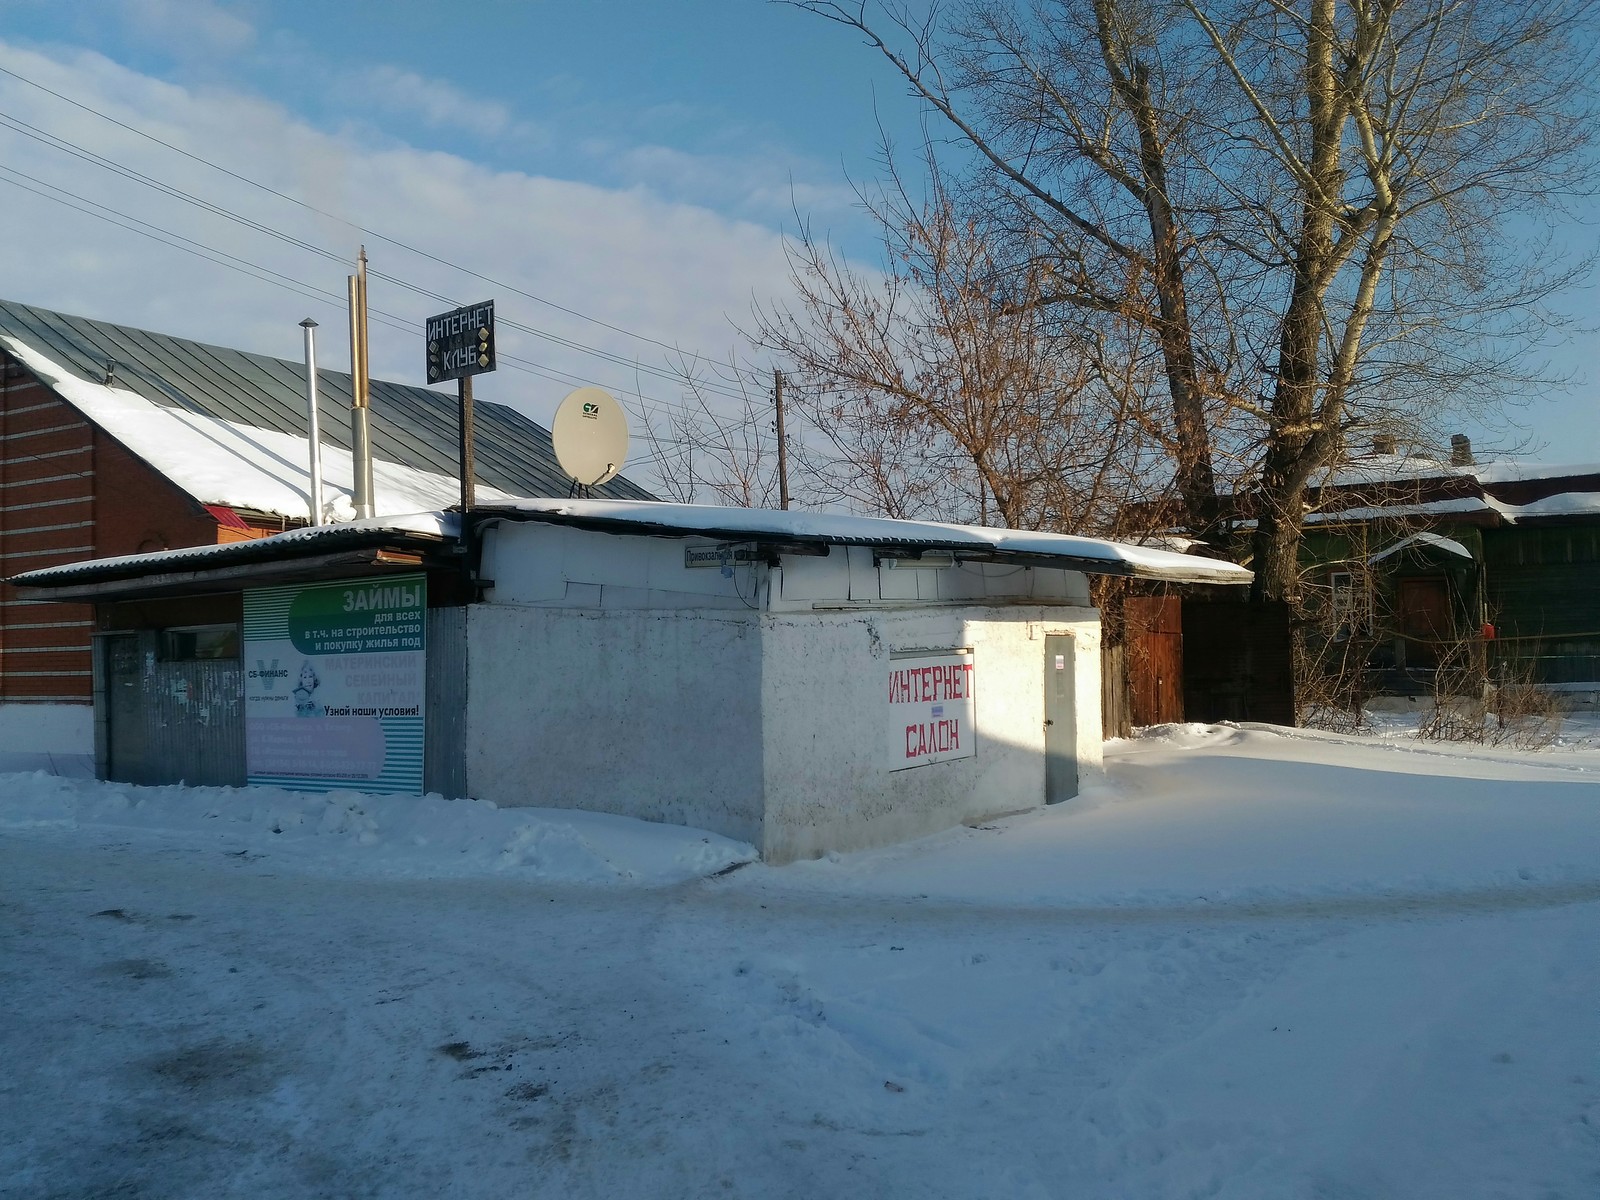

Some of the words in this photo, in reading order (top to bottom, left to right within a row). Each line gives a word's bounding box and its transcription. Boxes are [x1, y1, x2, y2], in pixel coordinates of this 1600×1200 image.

[428, 305, 493, 342] ИНТЕРНЕТ
[443, 345, 477, 371] КЛУБ
[687, 550, 732, 564] Привокзалья
[342, 584, 420, 612] ЗАЙМЫ
[374, 613, 393, 624] для
[396, 610, 421, 621] всех
[305, 631, 311, 639] в
[313, 630, 329, 639] т.ч.
[331, 629, 343, 638] на
[346, 624, 421, 638] строительство
[315, 642, 321, 651] и
[324, 640, 363, 652] покупку
[366, 638, 399, 648] жилья
[401, 637, 421, 648] под
[325, 655, 417, 671] МАТЕРИНСКИЙ
[249, 669, 289, 678] СБ-ФИНАНС
[345, 673, 417, 688] СЕМЕЙНЫЙ
[889, 663, 973, 704] ИНТЕРНЕТ
[323, 705, 351, 717] Узнай
[352, 707, 377, 716] наши
[379, 704, 419, 719] условия!
[905, 719, 960, 758] САЛОН
